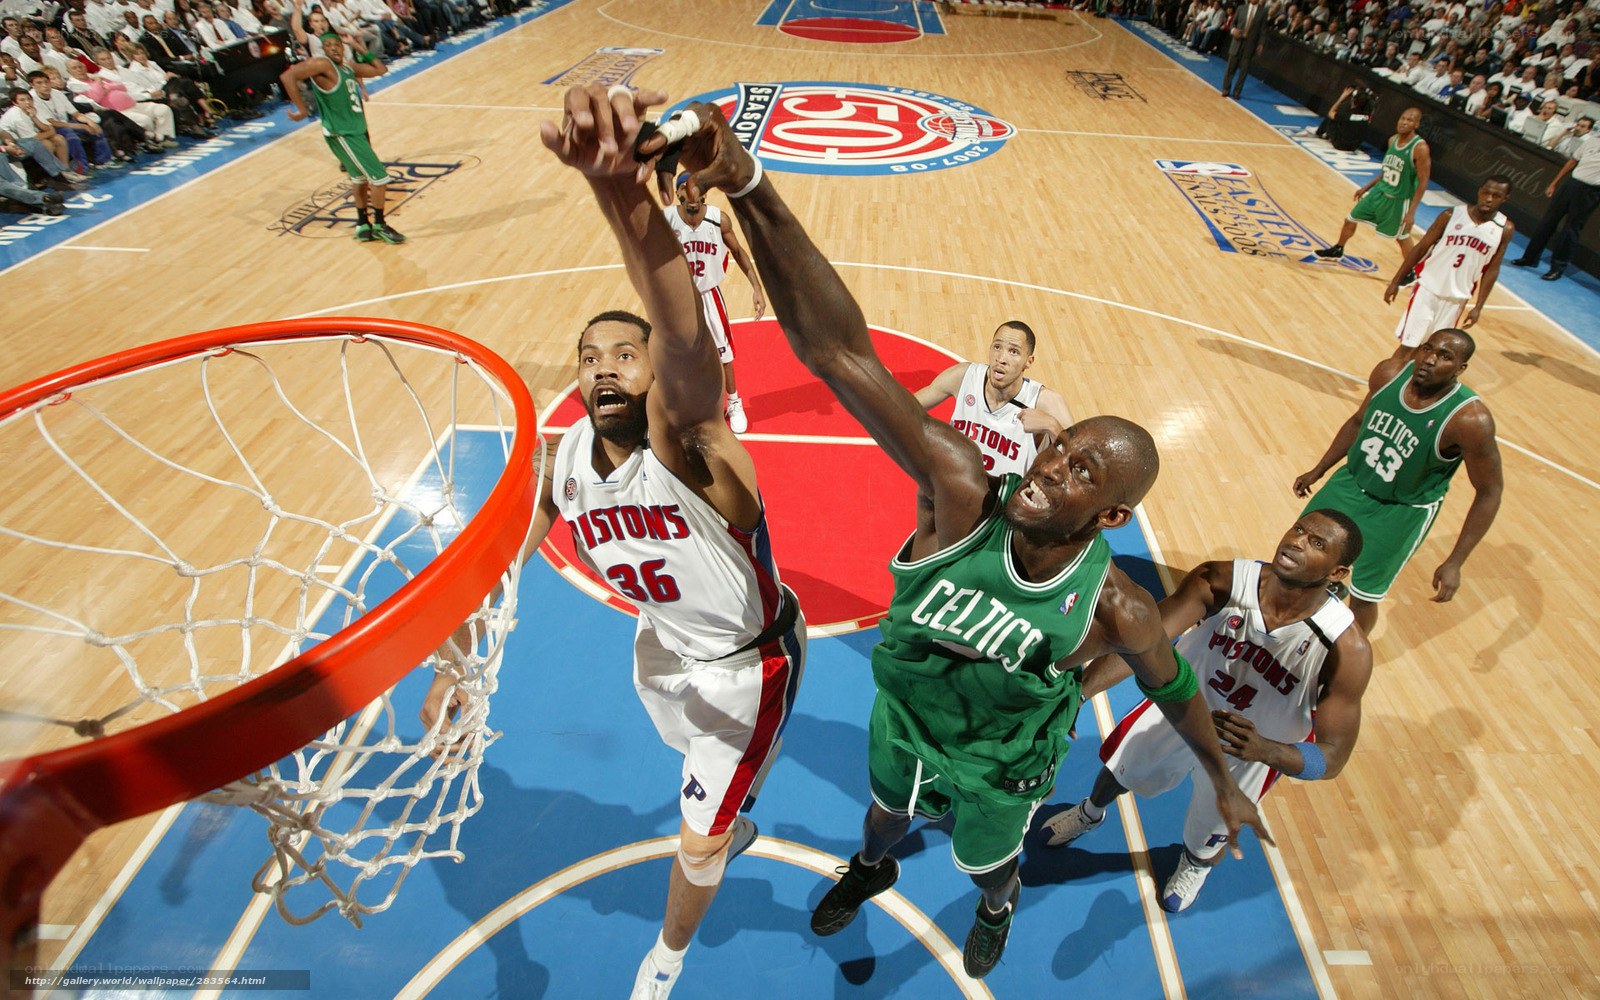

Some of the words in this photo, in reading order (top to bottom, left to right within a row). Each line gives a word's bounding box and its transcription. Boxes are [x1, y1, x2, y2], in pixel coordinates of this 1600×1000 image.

[772, 97, 903, 147] 50
[890, 145, 989, 172] 2007-08
[1382, 165, 1401, 187] 20
[1171, 172, 1227, 216] FINALS
[1213, 217, 1268, 257] 2008
[1191, 173, 1292, 262] CONFERENCE
[1212, 175, 1314, 253] EASTER
[683, 240, 718, 256] STONS
[1446, 235, 1492, 255] PISTONS
[1453, 253, 1466, 269] 3
[953, 419, 1021, 461] PISTONS
[1367, 409, 1420, 459] CELTICS
[1360, 436, 1403, 483] 43
[606, 558, 682, 603] 36
[911, 578, 1044, 673] CELTICS
[1208, 630, 1301, 696] PISTONS
[1207, 669, 1259, 712] 24
[682, 773, 707, 801] P
[1205, 833, 1228, 848] P
